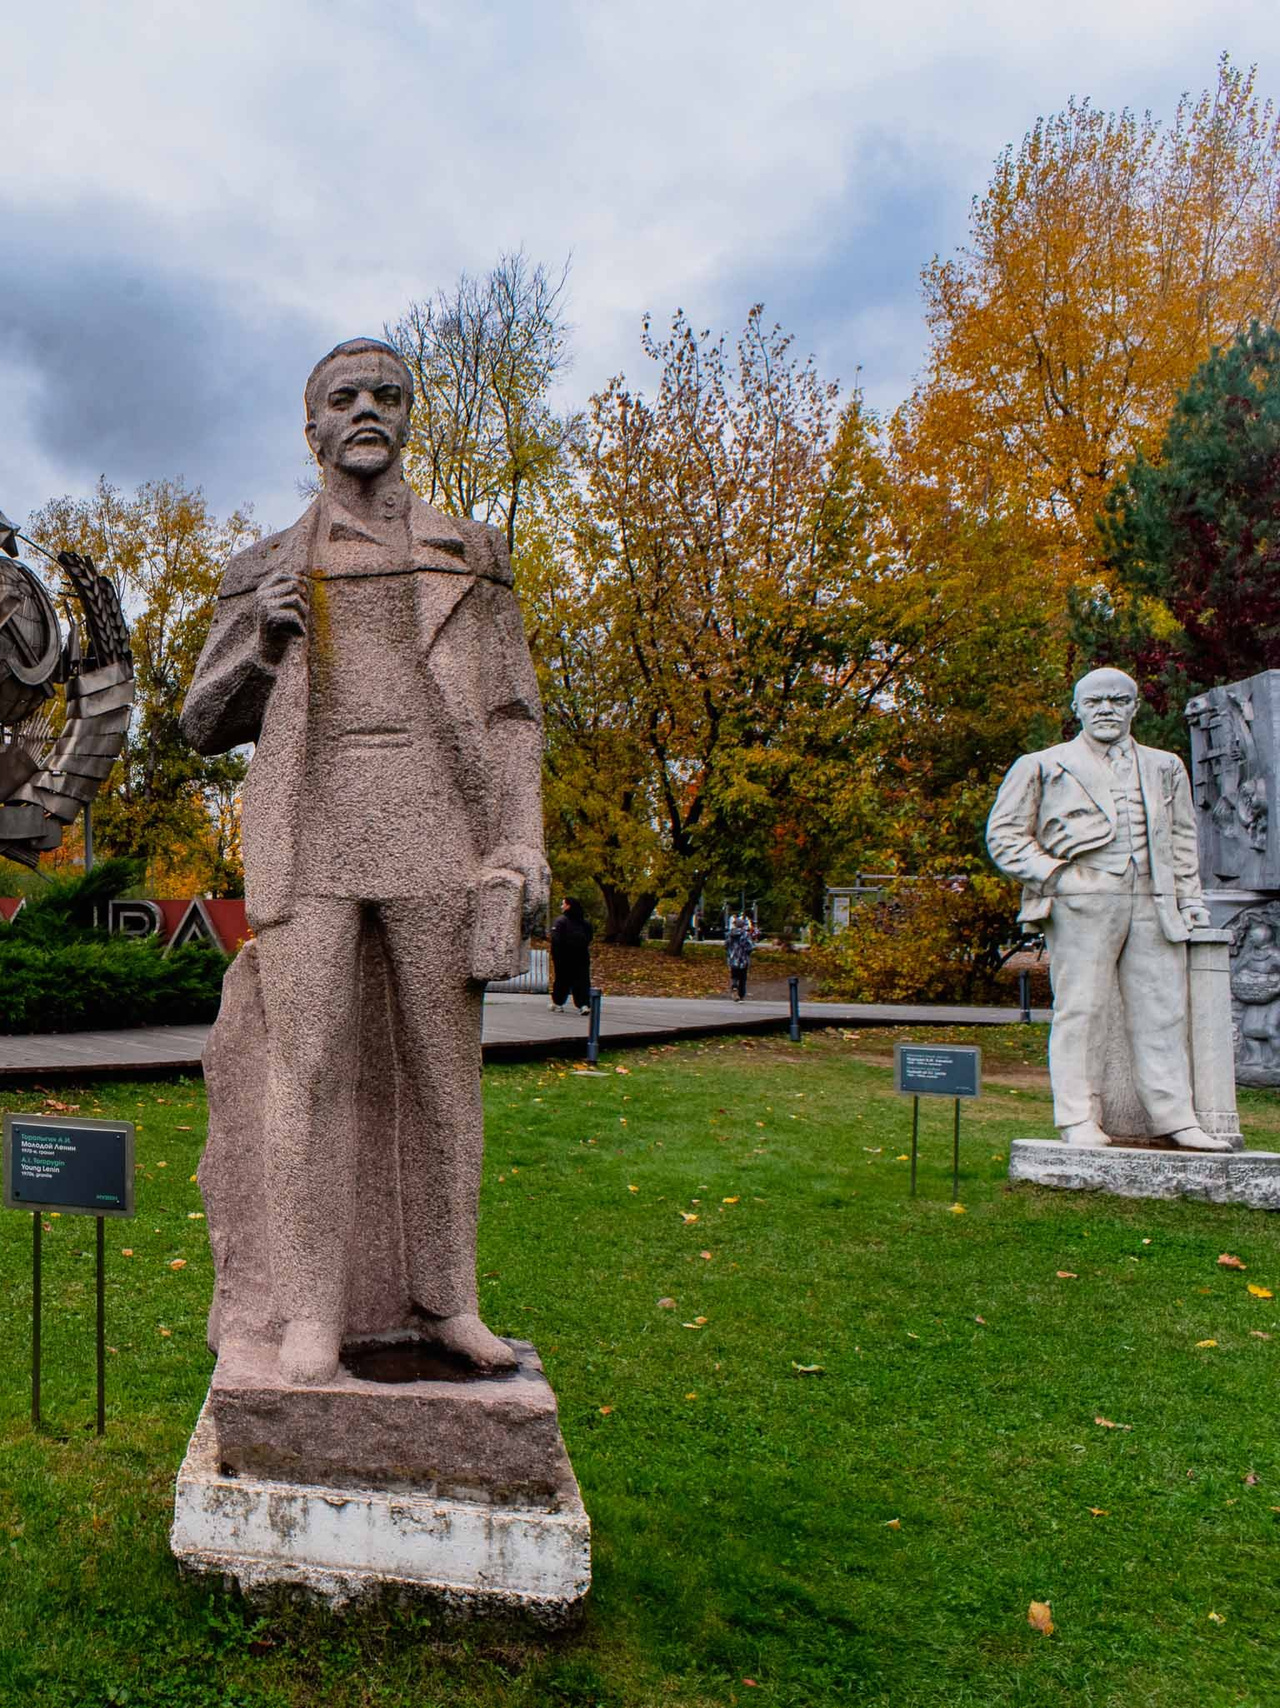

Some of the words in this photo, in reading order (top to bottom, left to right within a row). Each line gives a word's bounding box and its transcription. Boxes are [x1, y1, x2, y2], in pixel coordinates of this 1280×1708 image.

[21, 1141, 53, 1150] Молодой
[54, 1143, 76, 1151] Ленин
[21, 1164, 41, 1172] Young
[42, 1165, 60, 1173] Lenin
